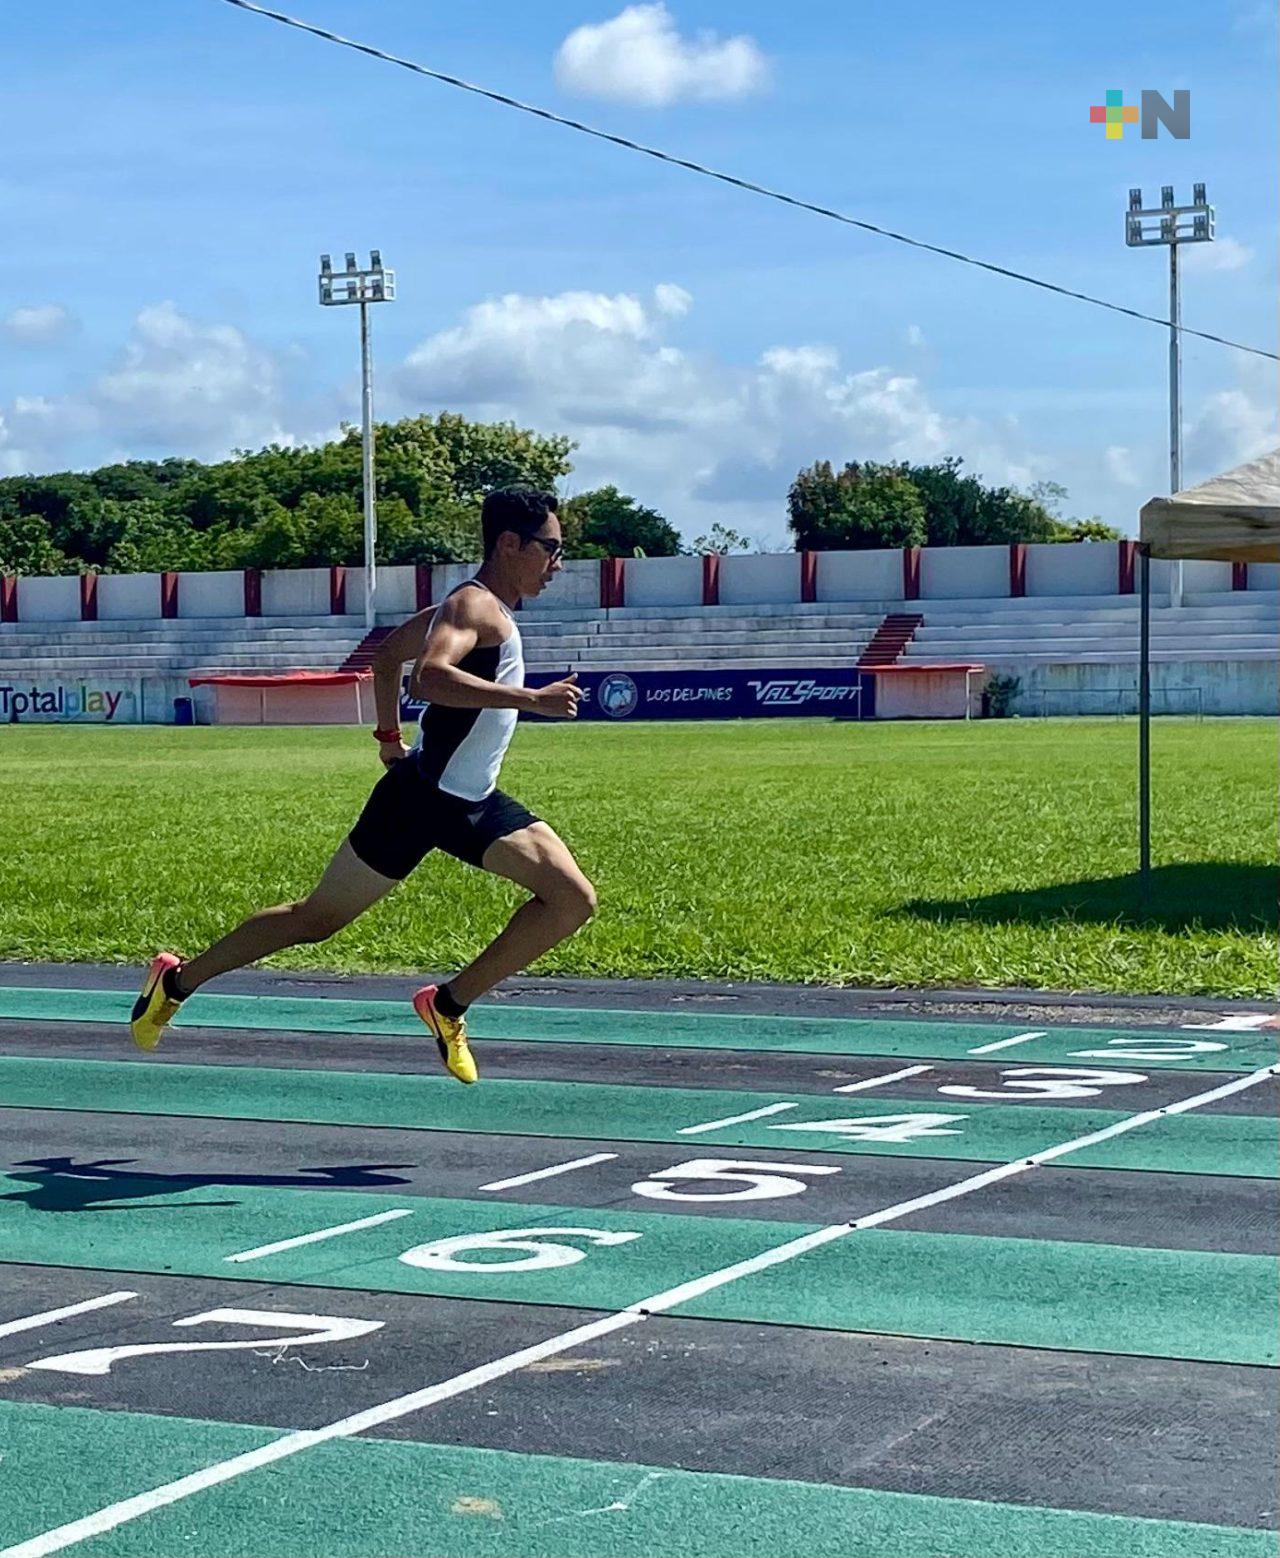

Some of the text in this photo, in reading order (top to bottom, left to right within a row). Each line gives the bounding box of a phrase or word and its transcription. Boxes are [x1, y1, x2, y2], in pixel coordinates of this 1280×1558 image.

[646, 689, 671, 702] LOS
[673, 687, 733, 701] DELFINES
[1066, 1038, 1229, 1060] 2
[937, 1068, 1149, 1099] 3
[766, 1113, 970, 1143] 4
[631, 1159, 843, 1202] 5
[398, 1227, 643, 1273] 6
[26, 1308, 386, 1375] 7
